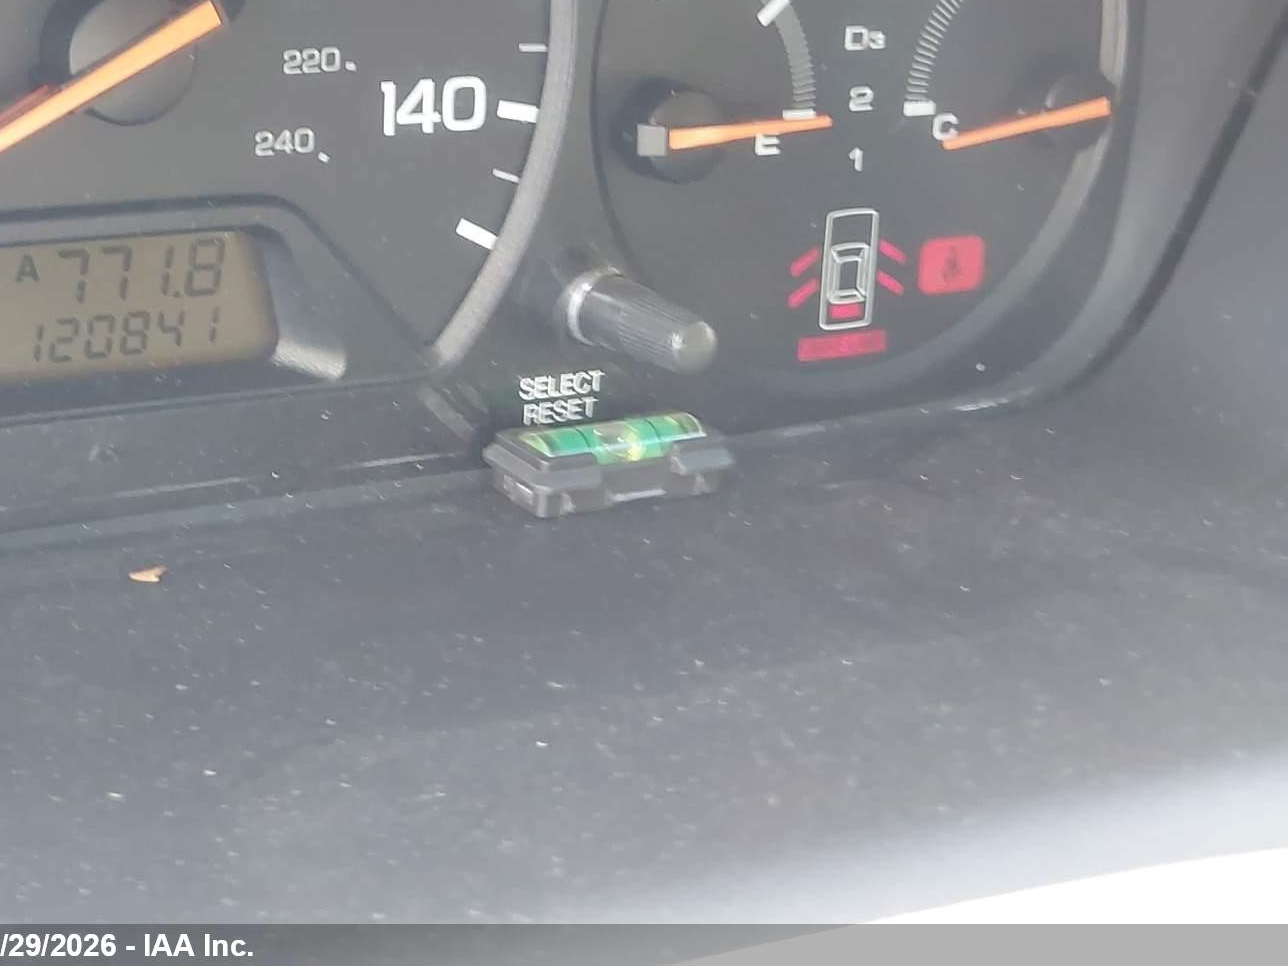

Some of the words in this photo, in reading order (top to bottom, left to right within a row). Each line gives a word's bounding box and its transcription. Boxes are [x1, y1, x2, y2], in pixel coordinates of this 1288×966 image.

[283, 47, 341, 75] 220
[380, 76, 487, 136] 140
[848, 86, 874, 112] 2
[254, 128, 315, 157] 240
[931, 113, 960, 143] C
[753, 132, 782, 156] E
[849, 147, 863, 172] 1
[15, 254, 40, 283] A
[32, 306, 220, 363] 120841
[518, 369, 606, 401] SELECT
[522, 395, 600, 426] RESET
